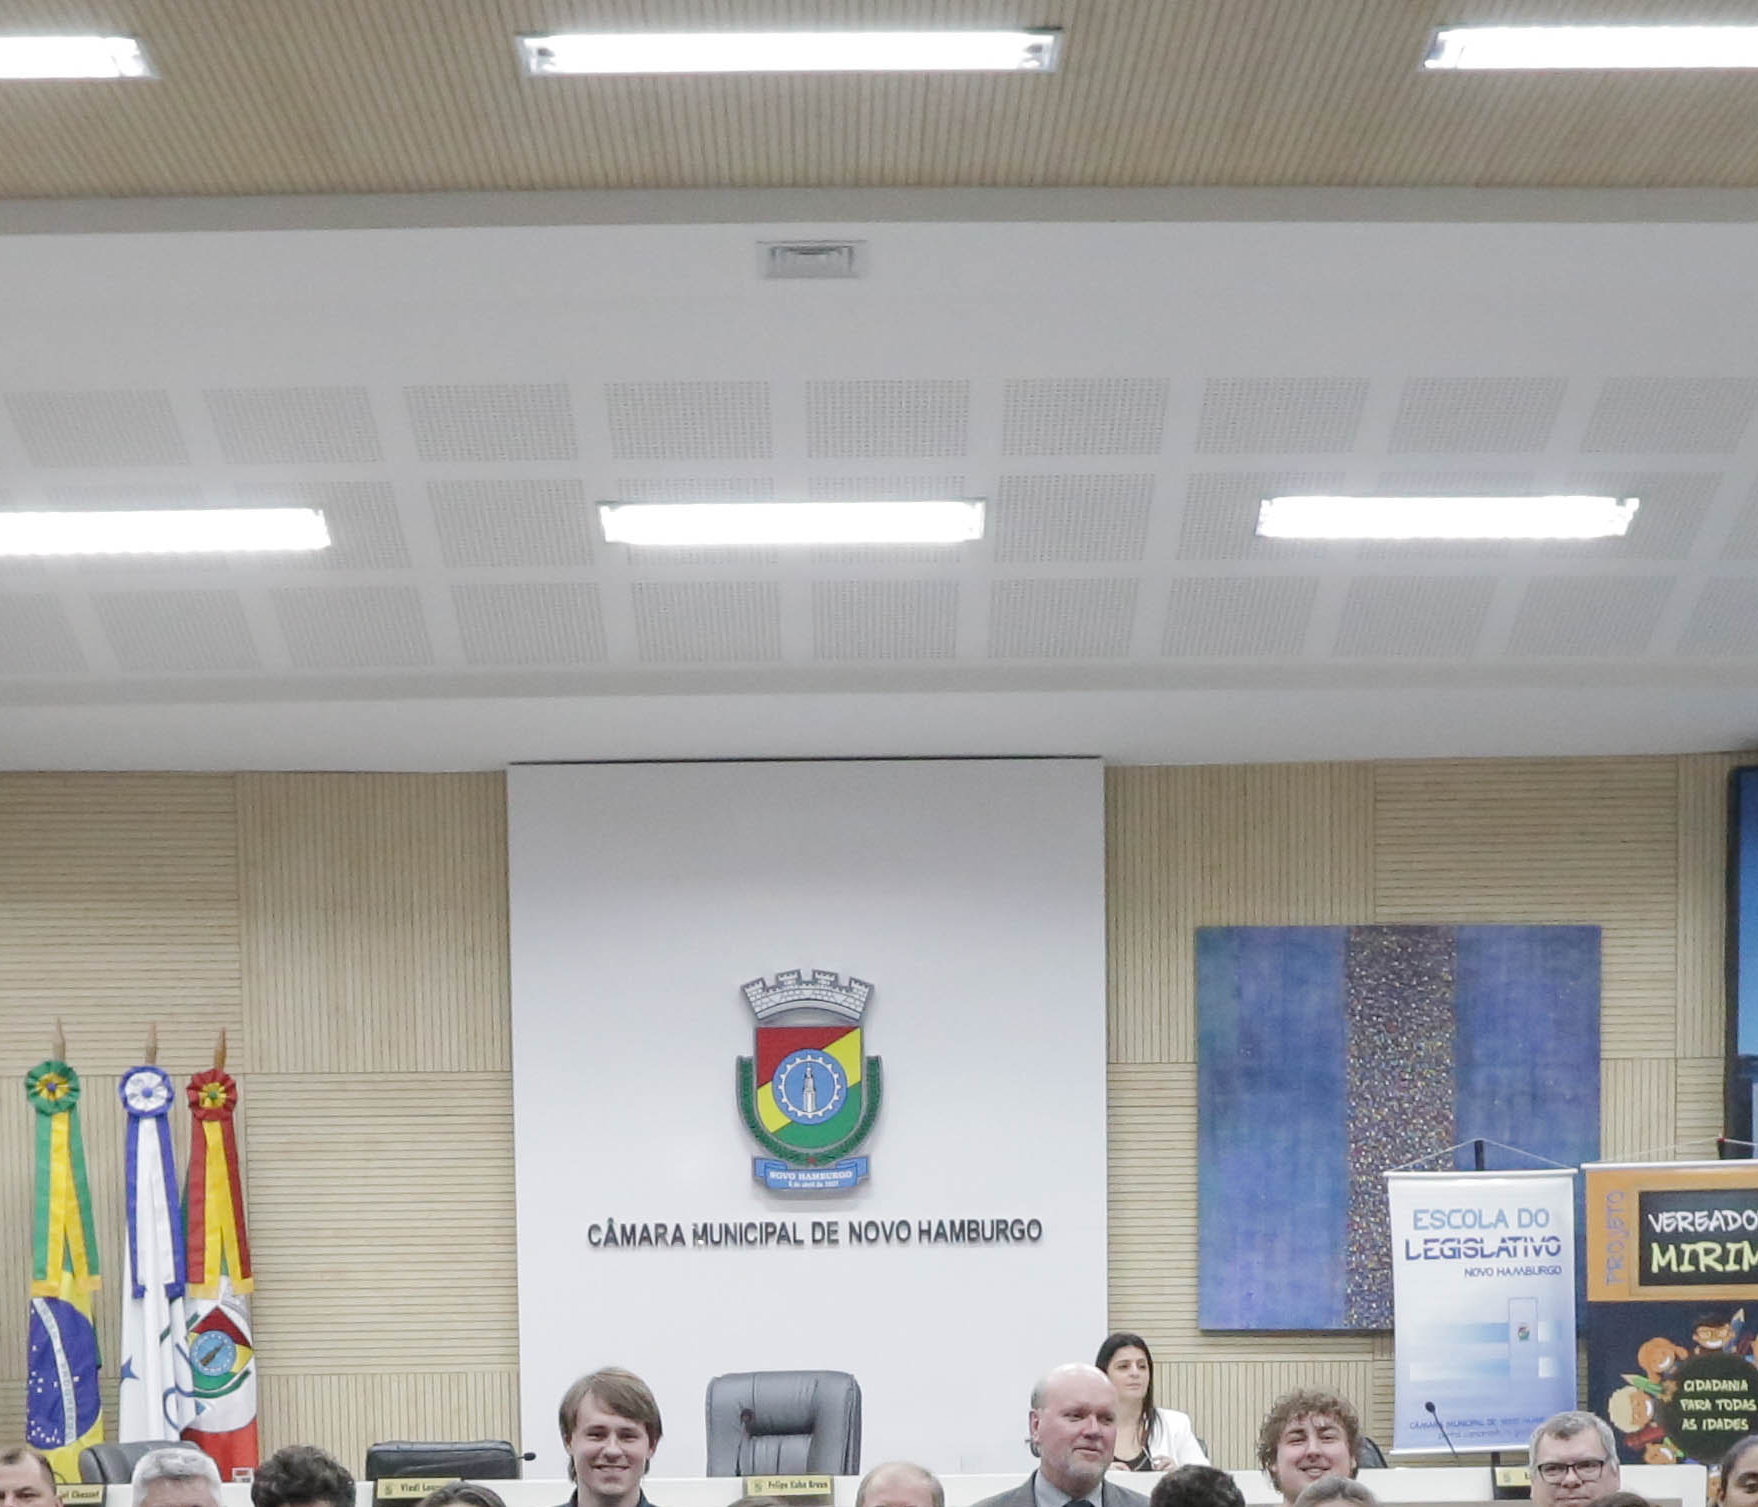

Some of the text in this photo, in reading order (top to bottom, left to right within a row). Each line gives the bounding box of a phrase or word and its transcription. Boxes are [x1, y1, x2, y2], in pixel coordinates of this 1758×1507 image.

[1413, 1208, 1550, 1231] ESCOLA DO
[587, 1217, 1042, 1247] CÂMARA MUNICIPAL DE NOVO HAMBURGO
[1405, 1235, 1562, 1261] LEGISLATIVO
[1464, 1265, 1562, 1277] NOVO HAMBURGO
[1683, 1379, 1749, 1392] CIDADANIA
[1680, 1398, 1757, 1411] PARA TODAS
[1682, 1418, 1749, 1431] AS IDADES
